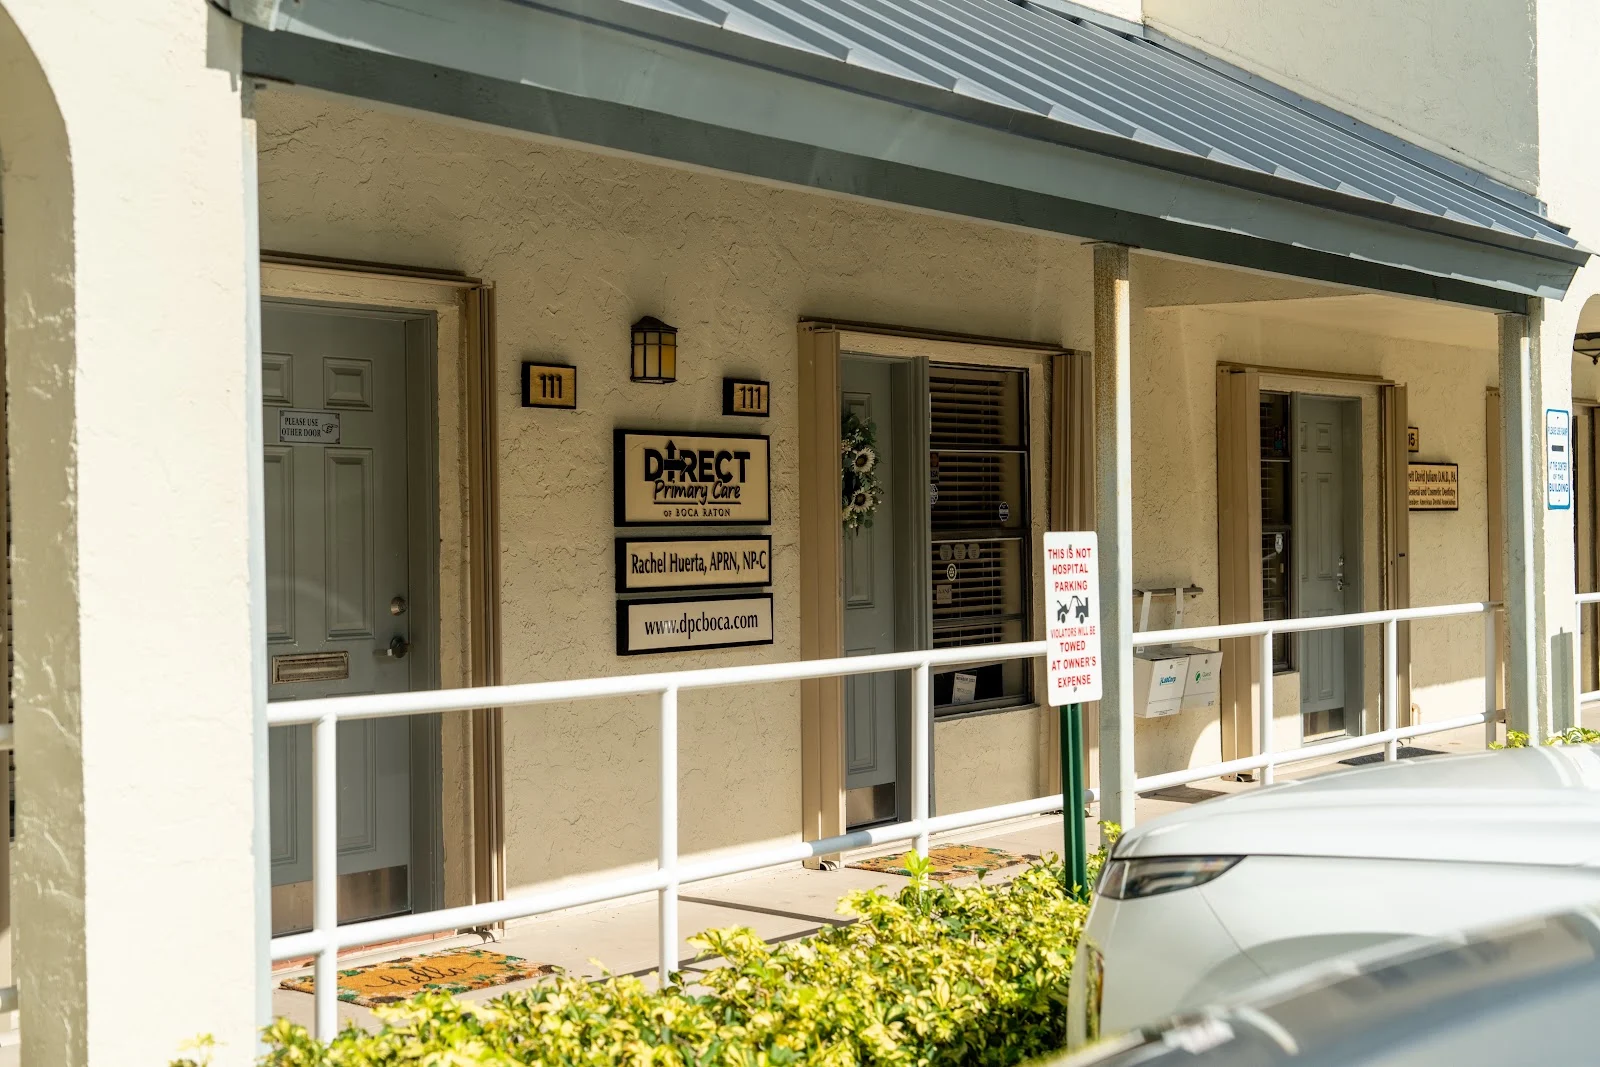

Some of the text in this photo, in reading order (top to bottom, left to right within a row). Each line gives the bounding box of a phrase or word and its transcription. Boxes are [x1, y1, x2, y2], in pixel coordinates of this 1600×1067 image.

[539, 373, 563, 399] 111
[738, 386, 762, 410] 111
[284, 417, 319, 427] PLEASE USE
[281, 428, 322, 438] OTHER DOOR
[643, 440, 751, 484] DIRECT
[653, 478, 741, 506] Primary Care
[1549, 483, 1569, 492] BUILDING
[676, 508, 699, 517] BOCA
[702, 508, 731, 517] RATON
[1048, 547, 1092, 559] THIS IS NOT
[631, 550, 767, 576] Rachel Huerta, APRN, NP-C
[1052, 563, 1088, 575] HOSPITAL
[1054, 580, 1088, 592] PARKING
[644, 611, 758, 640] www.dpcboca.com
[1050, 625, 1096, 639] VIOLATORS WILL BE
[1059, 640, 1086, 652] TOWED
[1051, 656, 1097, 671] AT OWNER'S
[1057, 674, 1091, 688] EXPENSE
[365, 961, 484, 988] hello
